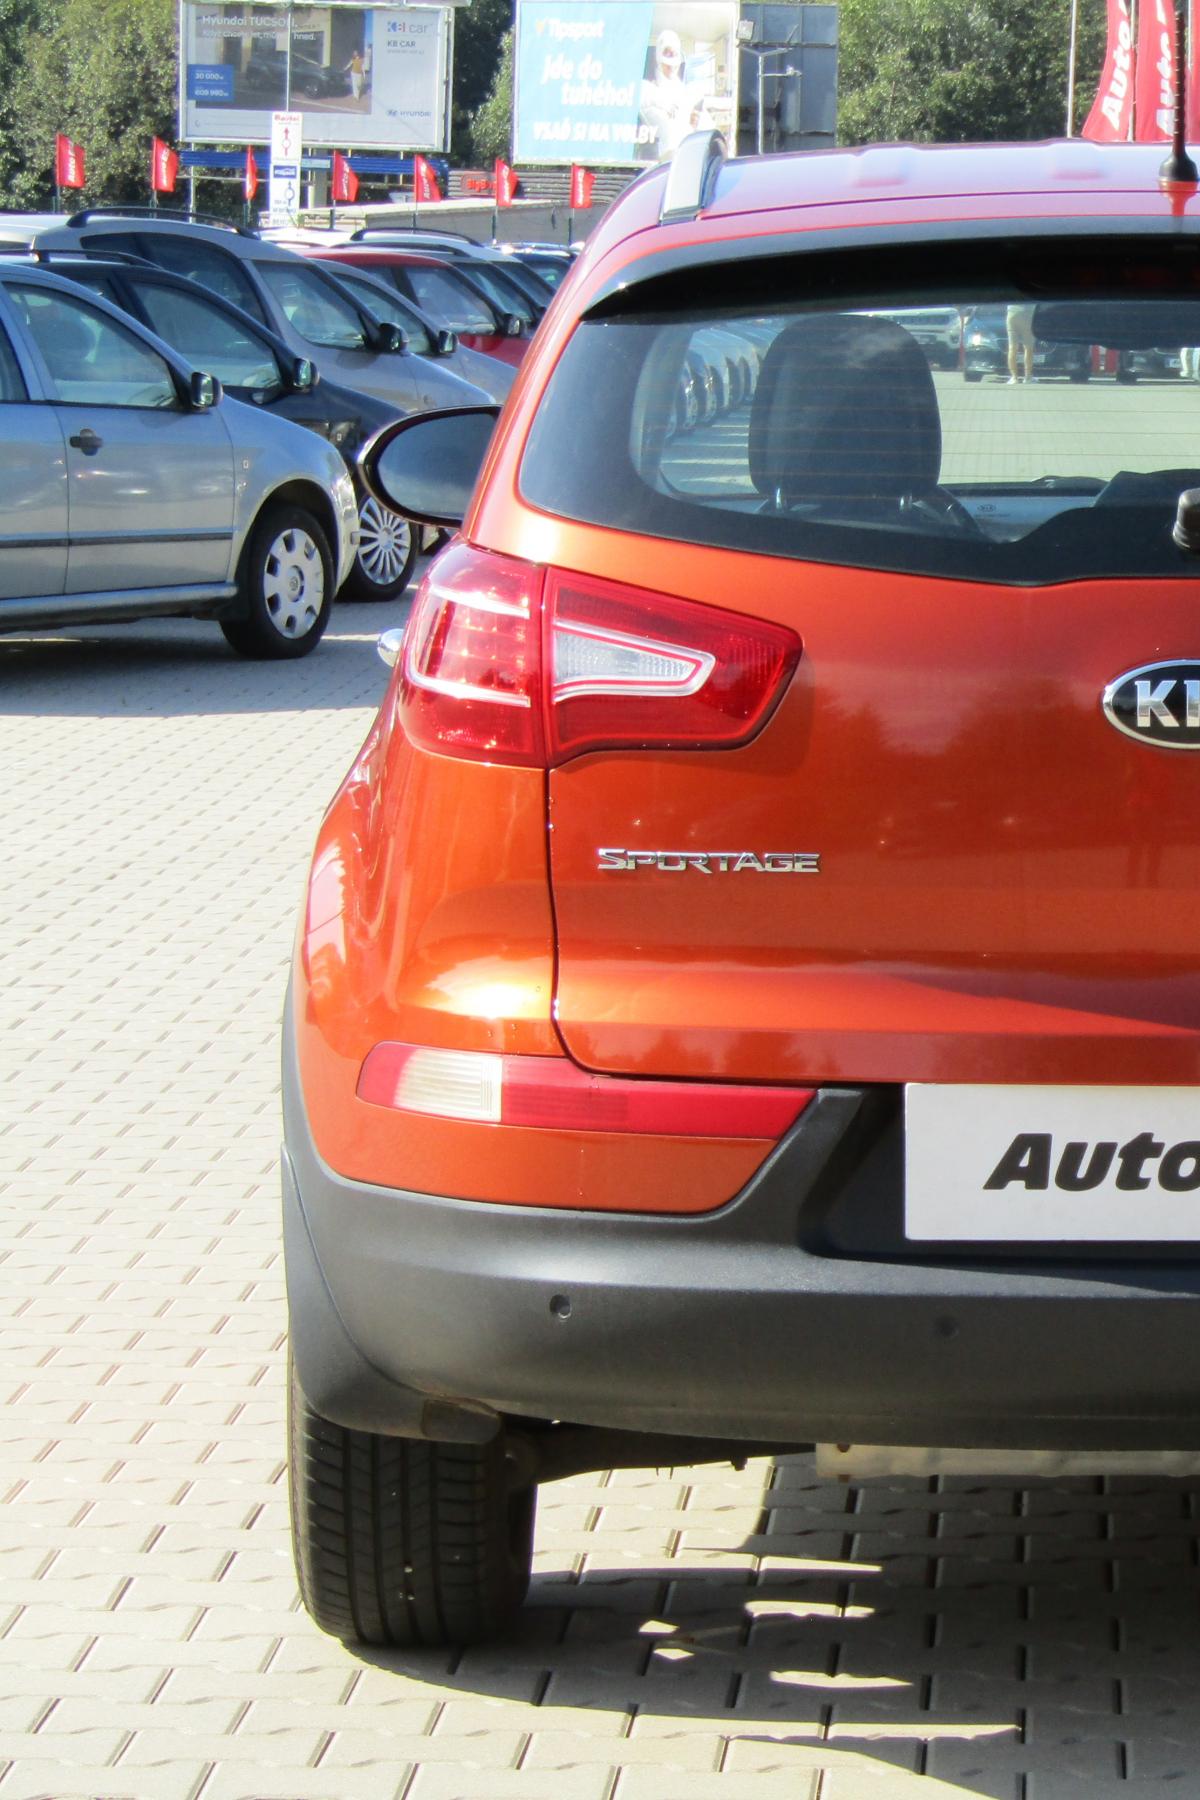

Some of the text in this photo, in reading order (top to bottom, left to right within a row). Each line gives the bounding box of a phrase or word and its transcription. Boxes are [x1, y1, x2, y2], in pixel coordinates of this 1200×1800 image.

[202, 15, 247, 26] Hyundai
[577, 53, 603, 80] do
[1101, 20, 1131, 131] Auto
[597, 848, 821, 874] SPORTAGE
